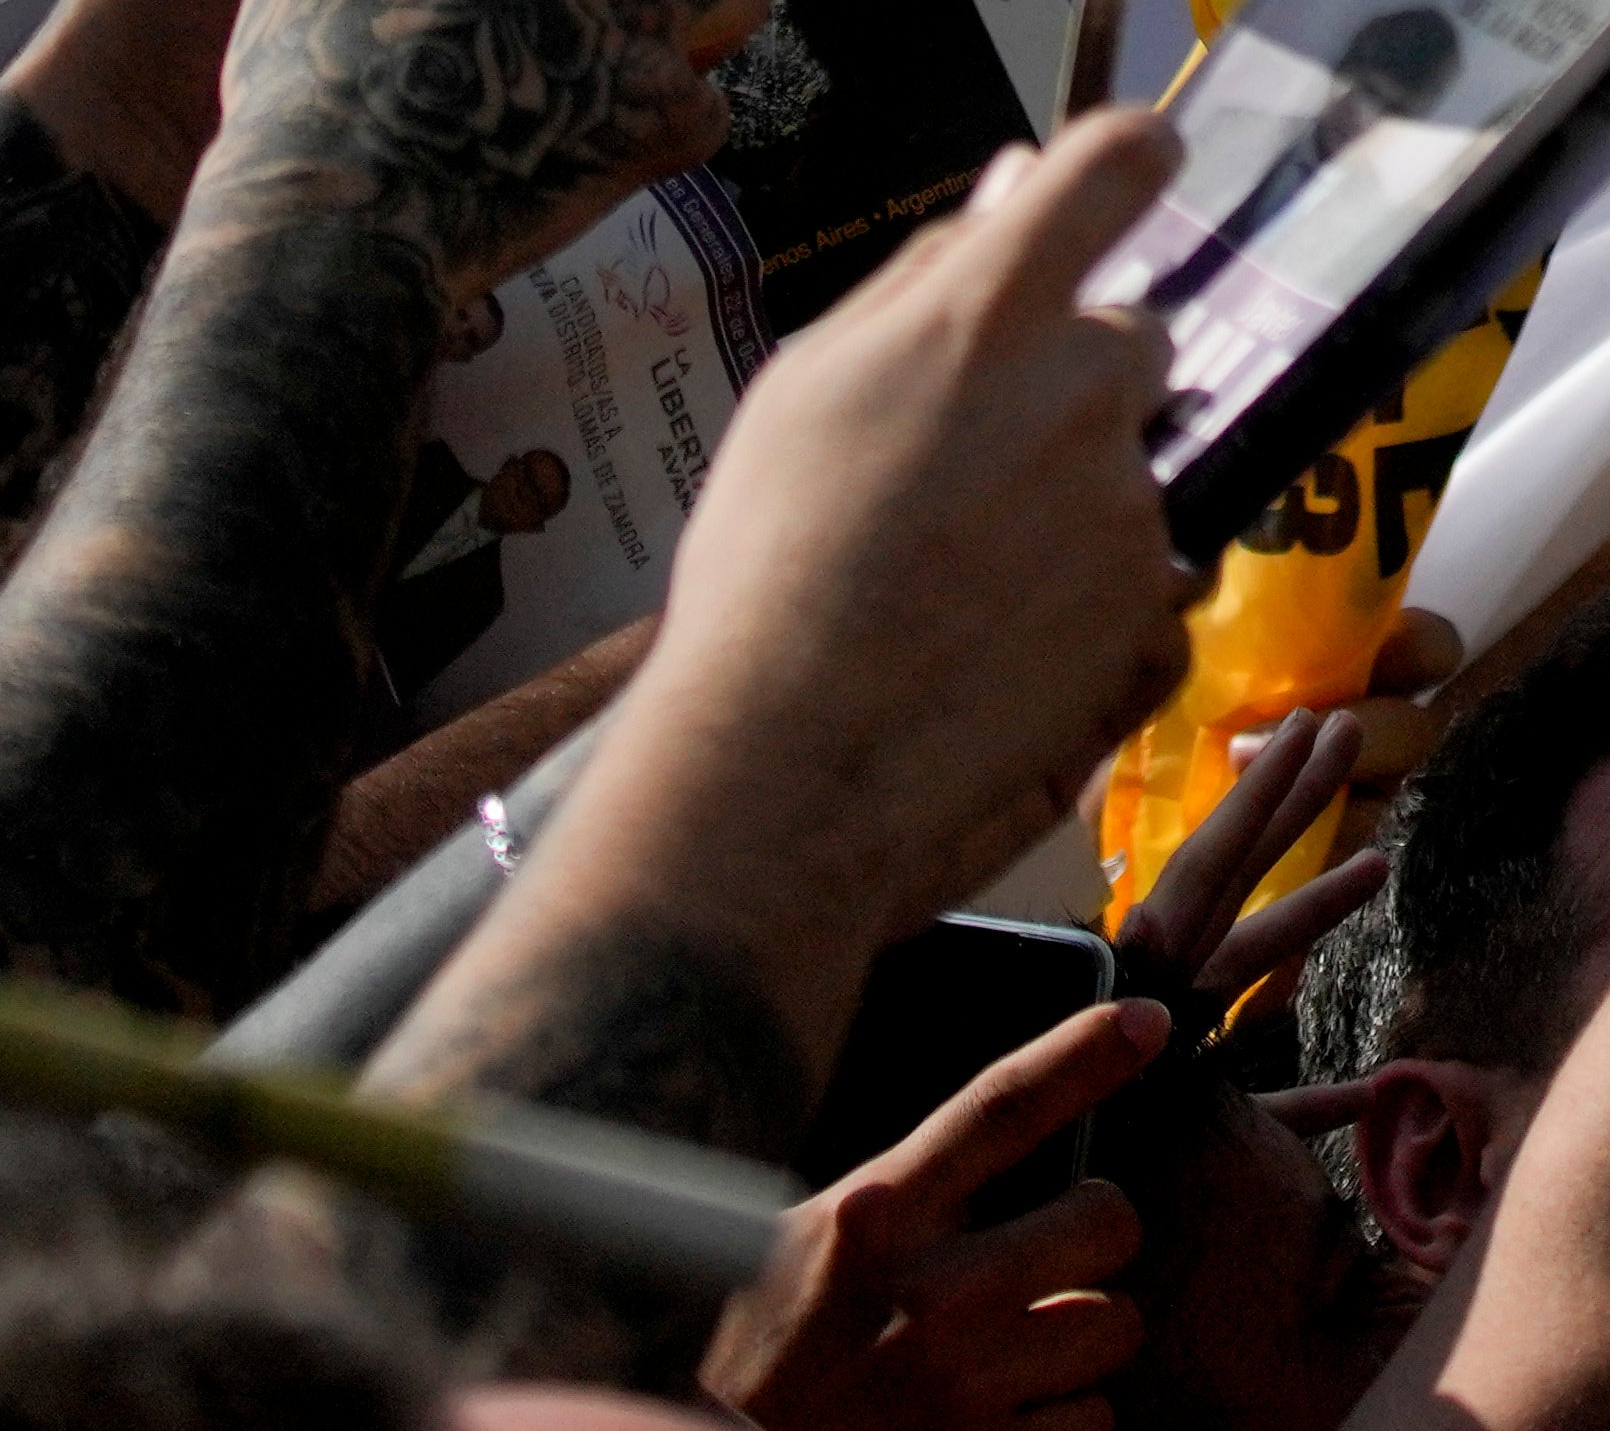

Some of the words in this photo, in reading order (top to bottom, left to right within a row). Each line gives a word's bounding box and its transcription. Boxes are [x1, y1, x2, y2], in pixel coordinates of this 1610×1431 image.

[762, 241, 813, 276] enos
[816, 215, 872, 250] Aires
[887, 167, 980, 220] Argentin
[673, 345, 695, 378] LA
[573, 392, 607, 461] LOMAS
[651, 357, 712, 489] LIBERT
[592, 460, 618, 487] DE
[656, 441, 697, 517] AVAN
[602, 487, 651, 571] ZAMORA
